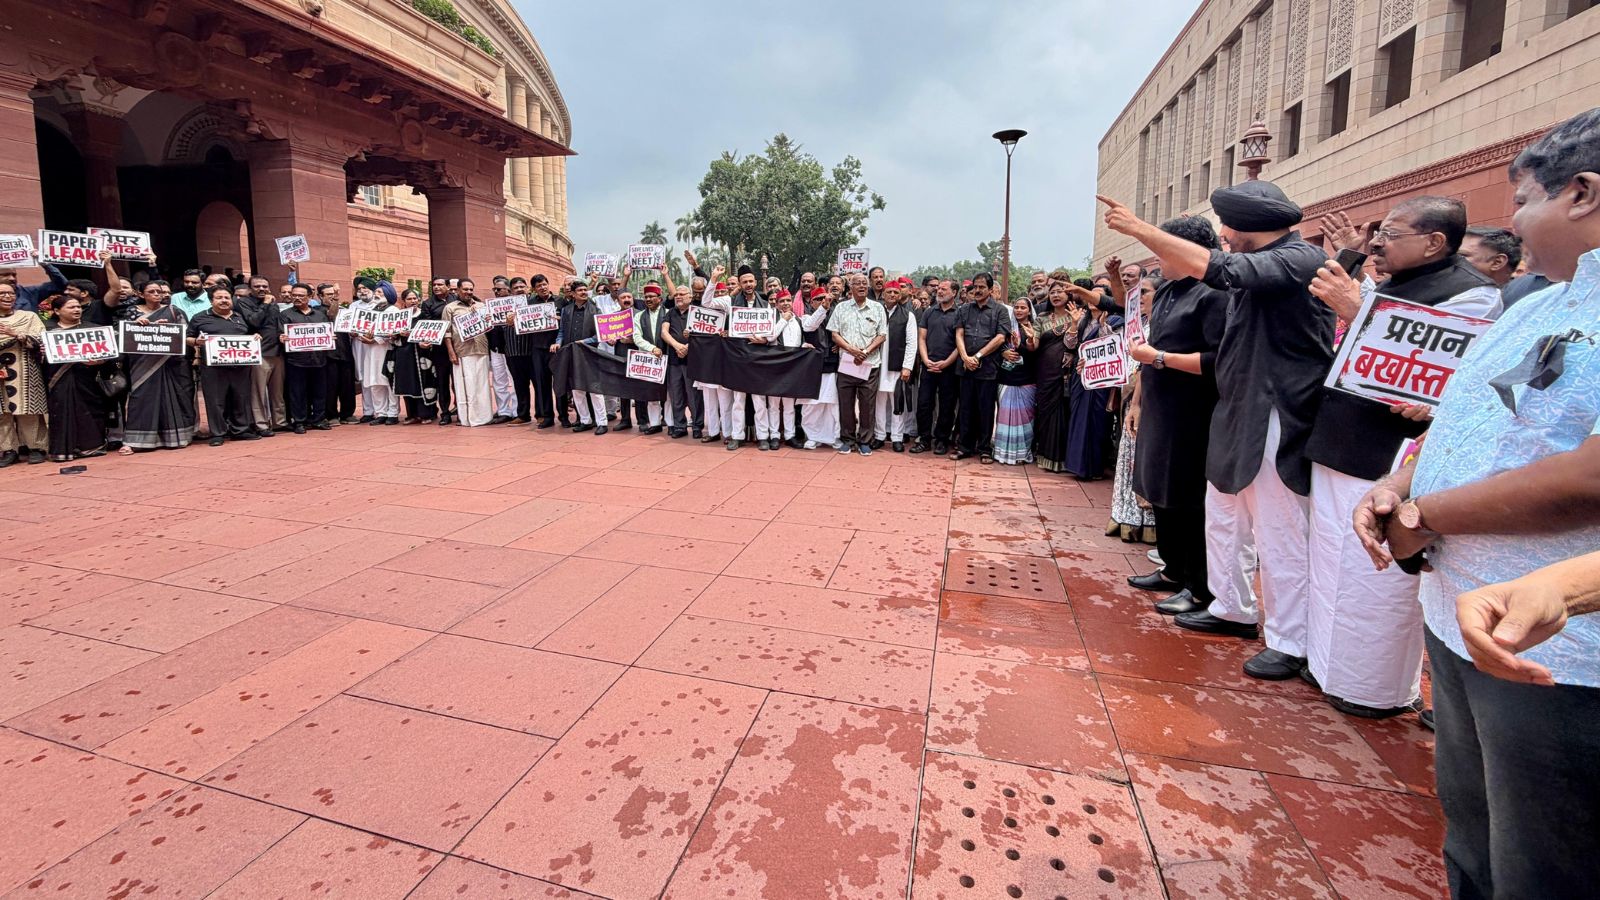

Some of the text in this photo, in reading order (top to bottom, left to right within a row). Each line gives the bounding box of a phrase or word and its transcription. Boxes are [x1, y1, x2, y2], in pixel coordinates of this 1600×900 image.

[49, 233, 98, 249] PAPER
[49, 246, 98, 260] LEAK
[843, 250, 864, 261] पेपर
[632, 257, 653, 265] NEET
[842, 259, 863, 269] लीक
[382, 311, 408, 321] PAPER
[694, 309, 719, 325] पेपर
[738, 311, 769, 320] प्रधान को
[381, 319, 408, 331] LEAK
[419, 322, 443, 330] PAPER
[463, 317, 479, 328] STOP
[463, 320, 482, 336] NEET
[520, 317, 544, 329] NEET
[693, 320, 717, 333] लीक
[734, 320, 772, 332] बर्खास्त करो
[125, 324, 180, 334] Democracy Bleeds
[294, 325, 326, 336] प्रधान को
[414, 330, 440, 339] LEAK
[53, 331, 105, 345] PAPER
[291, 335, 330, 347] बर्खास्त करो
[1382, 315, 1477, 359] प्रधान
[56, 341, 109, 356] LEAK
[217, 338, 251, 349] पेपर
[1085, 338, 1117, 360] प्रधान को
[219, 347, 252, 358] लीक
[1085, 356, 1123, 380] बर्खास्त करो
[1354, 345, 1456, 398] बर्खास्त
